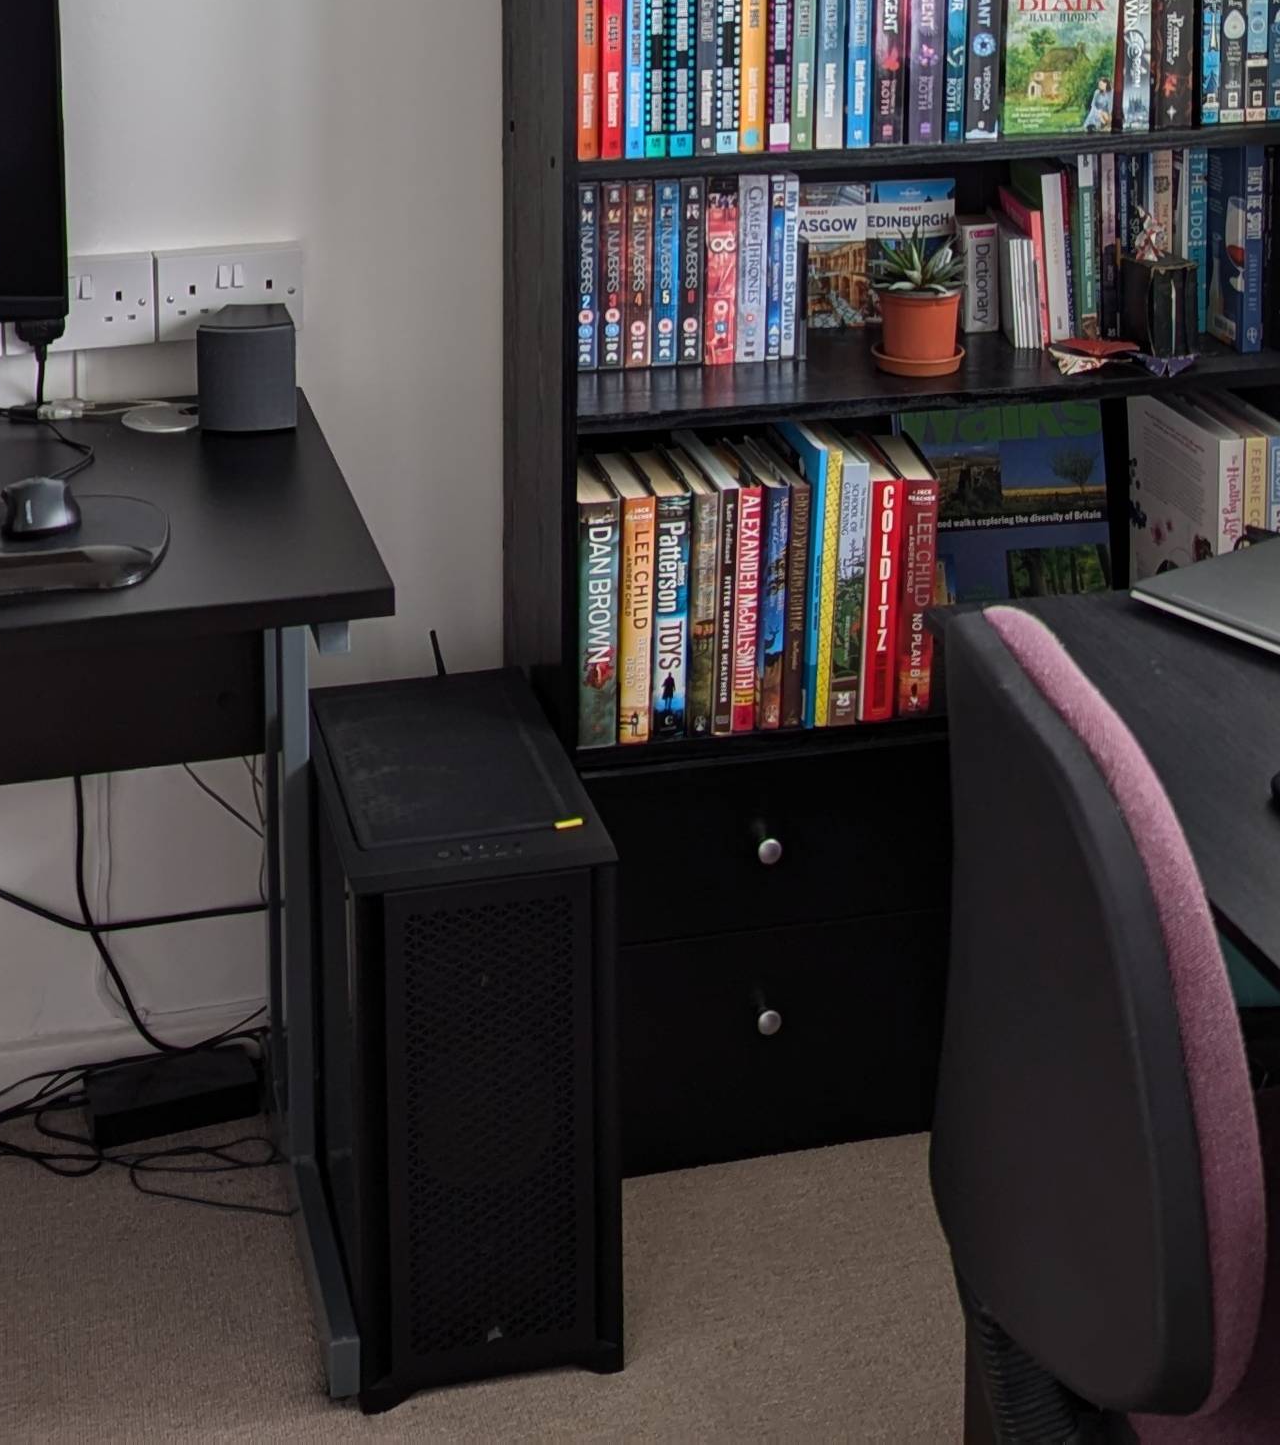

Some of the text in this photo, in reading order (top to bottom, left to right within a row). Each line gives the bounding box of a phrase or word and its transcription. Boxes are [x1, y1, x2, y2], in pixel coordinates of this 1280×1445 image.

[1029, 13, 1056, 22] HALF
[881, 80, 890, 114] ROTH
[918, 76, 927, 110] ROTH
[947, 78, 956, 112] ROTH
[982, 66, 991, 111] VERONICA
[868, 214, 949, 228] EDINBURGH
[1190, 163, 1203, 239] THE LIDO
[1247, 195, 1262, 210] THE
[748, 186, 763, 305] GAME THRONES
[799, 218, 857, 233] ASGOW
[783, 191, 797, 340] My Tandem Skydive
[974, 243, 990, 325] Dictionary
[634, 293, 643, 306] 4
[662, 290, 670, 304] 5
[1223, 467, 1240, 514] Healthy
[1250, 448, 1261, 503] FEARNE
[841, 482, 851, 535] GARDENING
[850, 483, 859, 533] SCHOOL OF
[977, 516, 1014, 528] exploring
[1015, 515, 1028, 523] the
[1030, 512, 1064, 524] diversity
[1065, 511, 1073, 519] of
[1074, 510, 1102, 519] Britain
[724, 524, 732, 564] Ferdinand
[739, 495, 760, 589] ALEXANDER
[915, 512, 932, 606] LEE CHILD
[633, 531, 650, 630] LEE CHILD
[658, 522, 683, 613] Patterson
[678, 561, 687, 586] James
[876, 485, 894, 652] COLDITZ
[588, 526, 612, 664] DAN BROWN
[722, 576, 731, 607] FITTER
[658, 622, 682, 670] TOYS
[721, 610, 730, 649] HAPPIER
[910, 613, 923, 678] NO PLAN B
[720, 652, 729, 702] HEALTHIER
